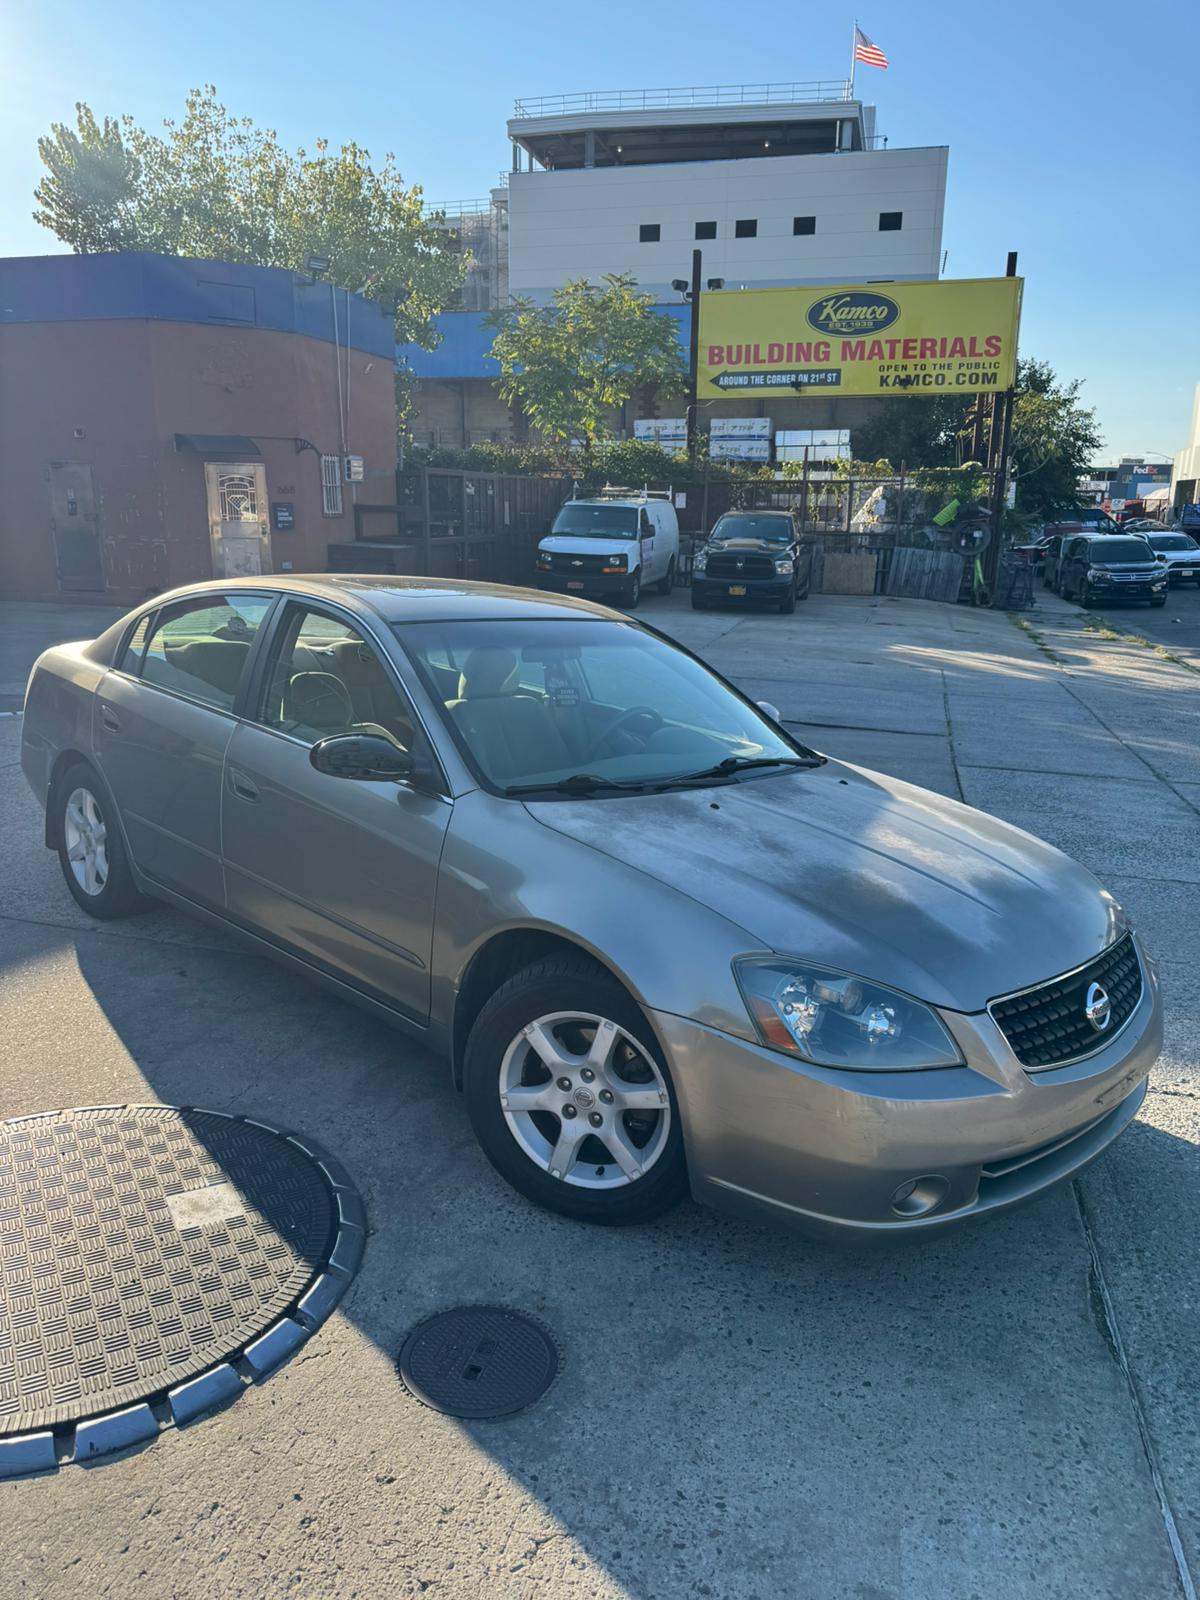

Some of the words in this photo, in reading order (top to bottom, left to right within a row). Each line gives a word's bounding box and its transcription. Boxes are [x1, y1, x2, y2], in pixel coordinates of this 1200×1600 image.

[819, 297, 889, 322] Kamco
[709, 341, 830, 365] BUILDING
[841, 336, 1002, 362] MATERIALS
[879, 363, 908, 373] OPEN
[913, 363, 926, 371] TO
[932, 362, 953, 371] THE
[958, 361, 1001, 370] PUBLIC
[719, 376, 749, 386] AROUND
[751, 375, 764, 385] THE
[766, 374, 796, 385] CORNER
[798, 373, 808, 383] ON
[827, 372, 837, 382] ST
[880, 372, 997, 387] KAMCO.COM
[1133, 465, 1158, 475] FedEx
